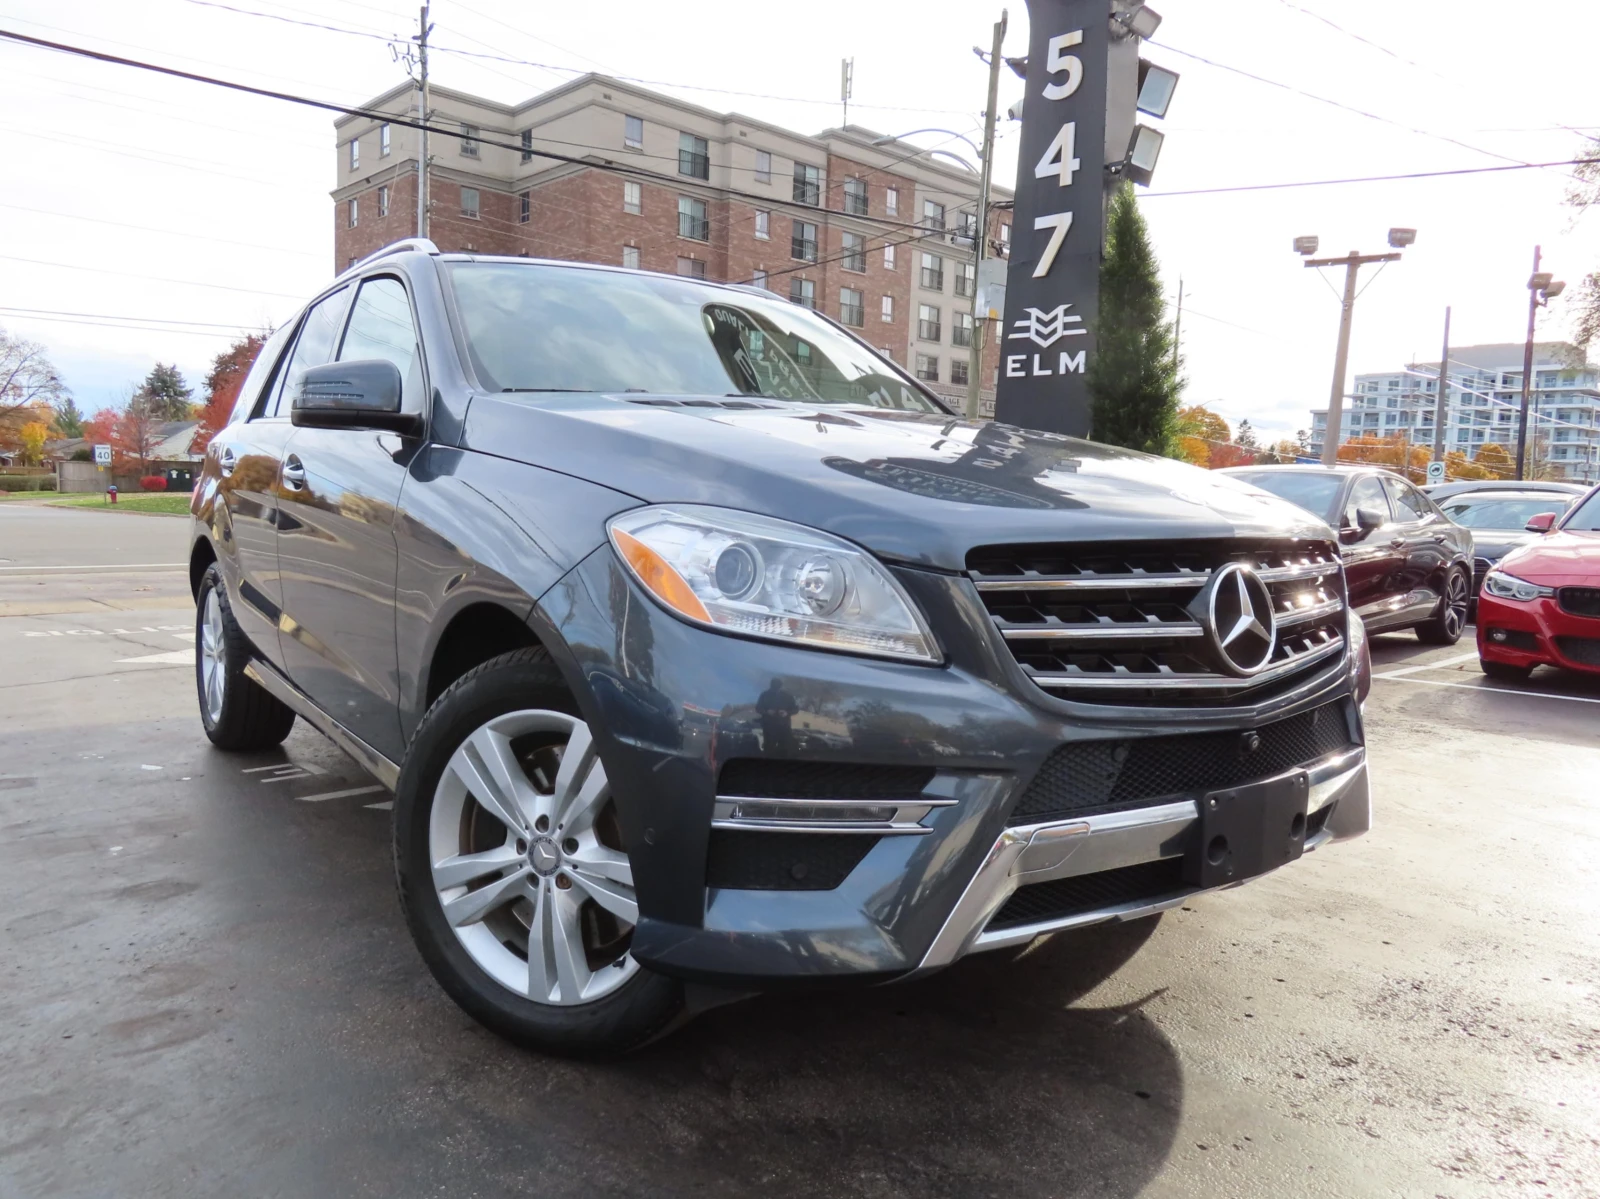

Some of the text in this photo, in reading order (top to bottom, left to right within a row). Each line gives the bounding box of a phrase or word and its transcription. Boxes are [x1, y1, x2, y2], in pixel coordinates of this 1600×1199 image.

[1032, 29, 1083, 278] 547
[1006, 350, 1086, 378] ELM
[97, 451, 110, 460] 40
